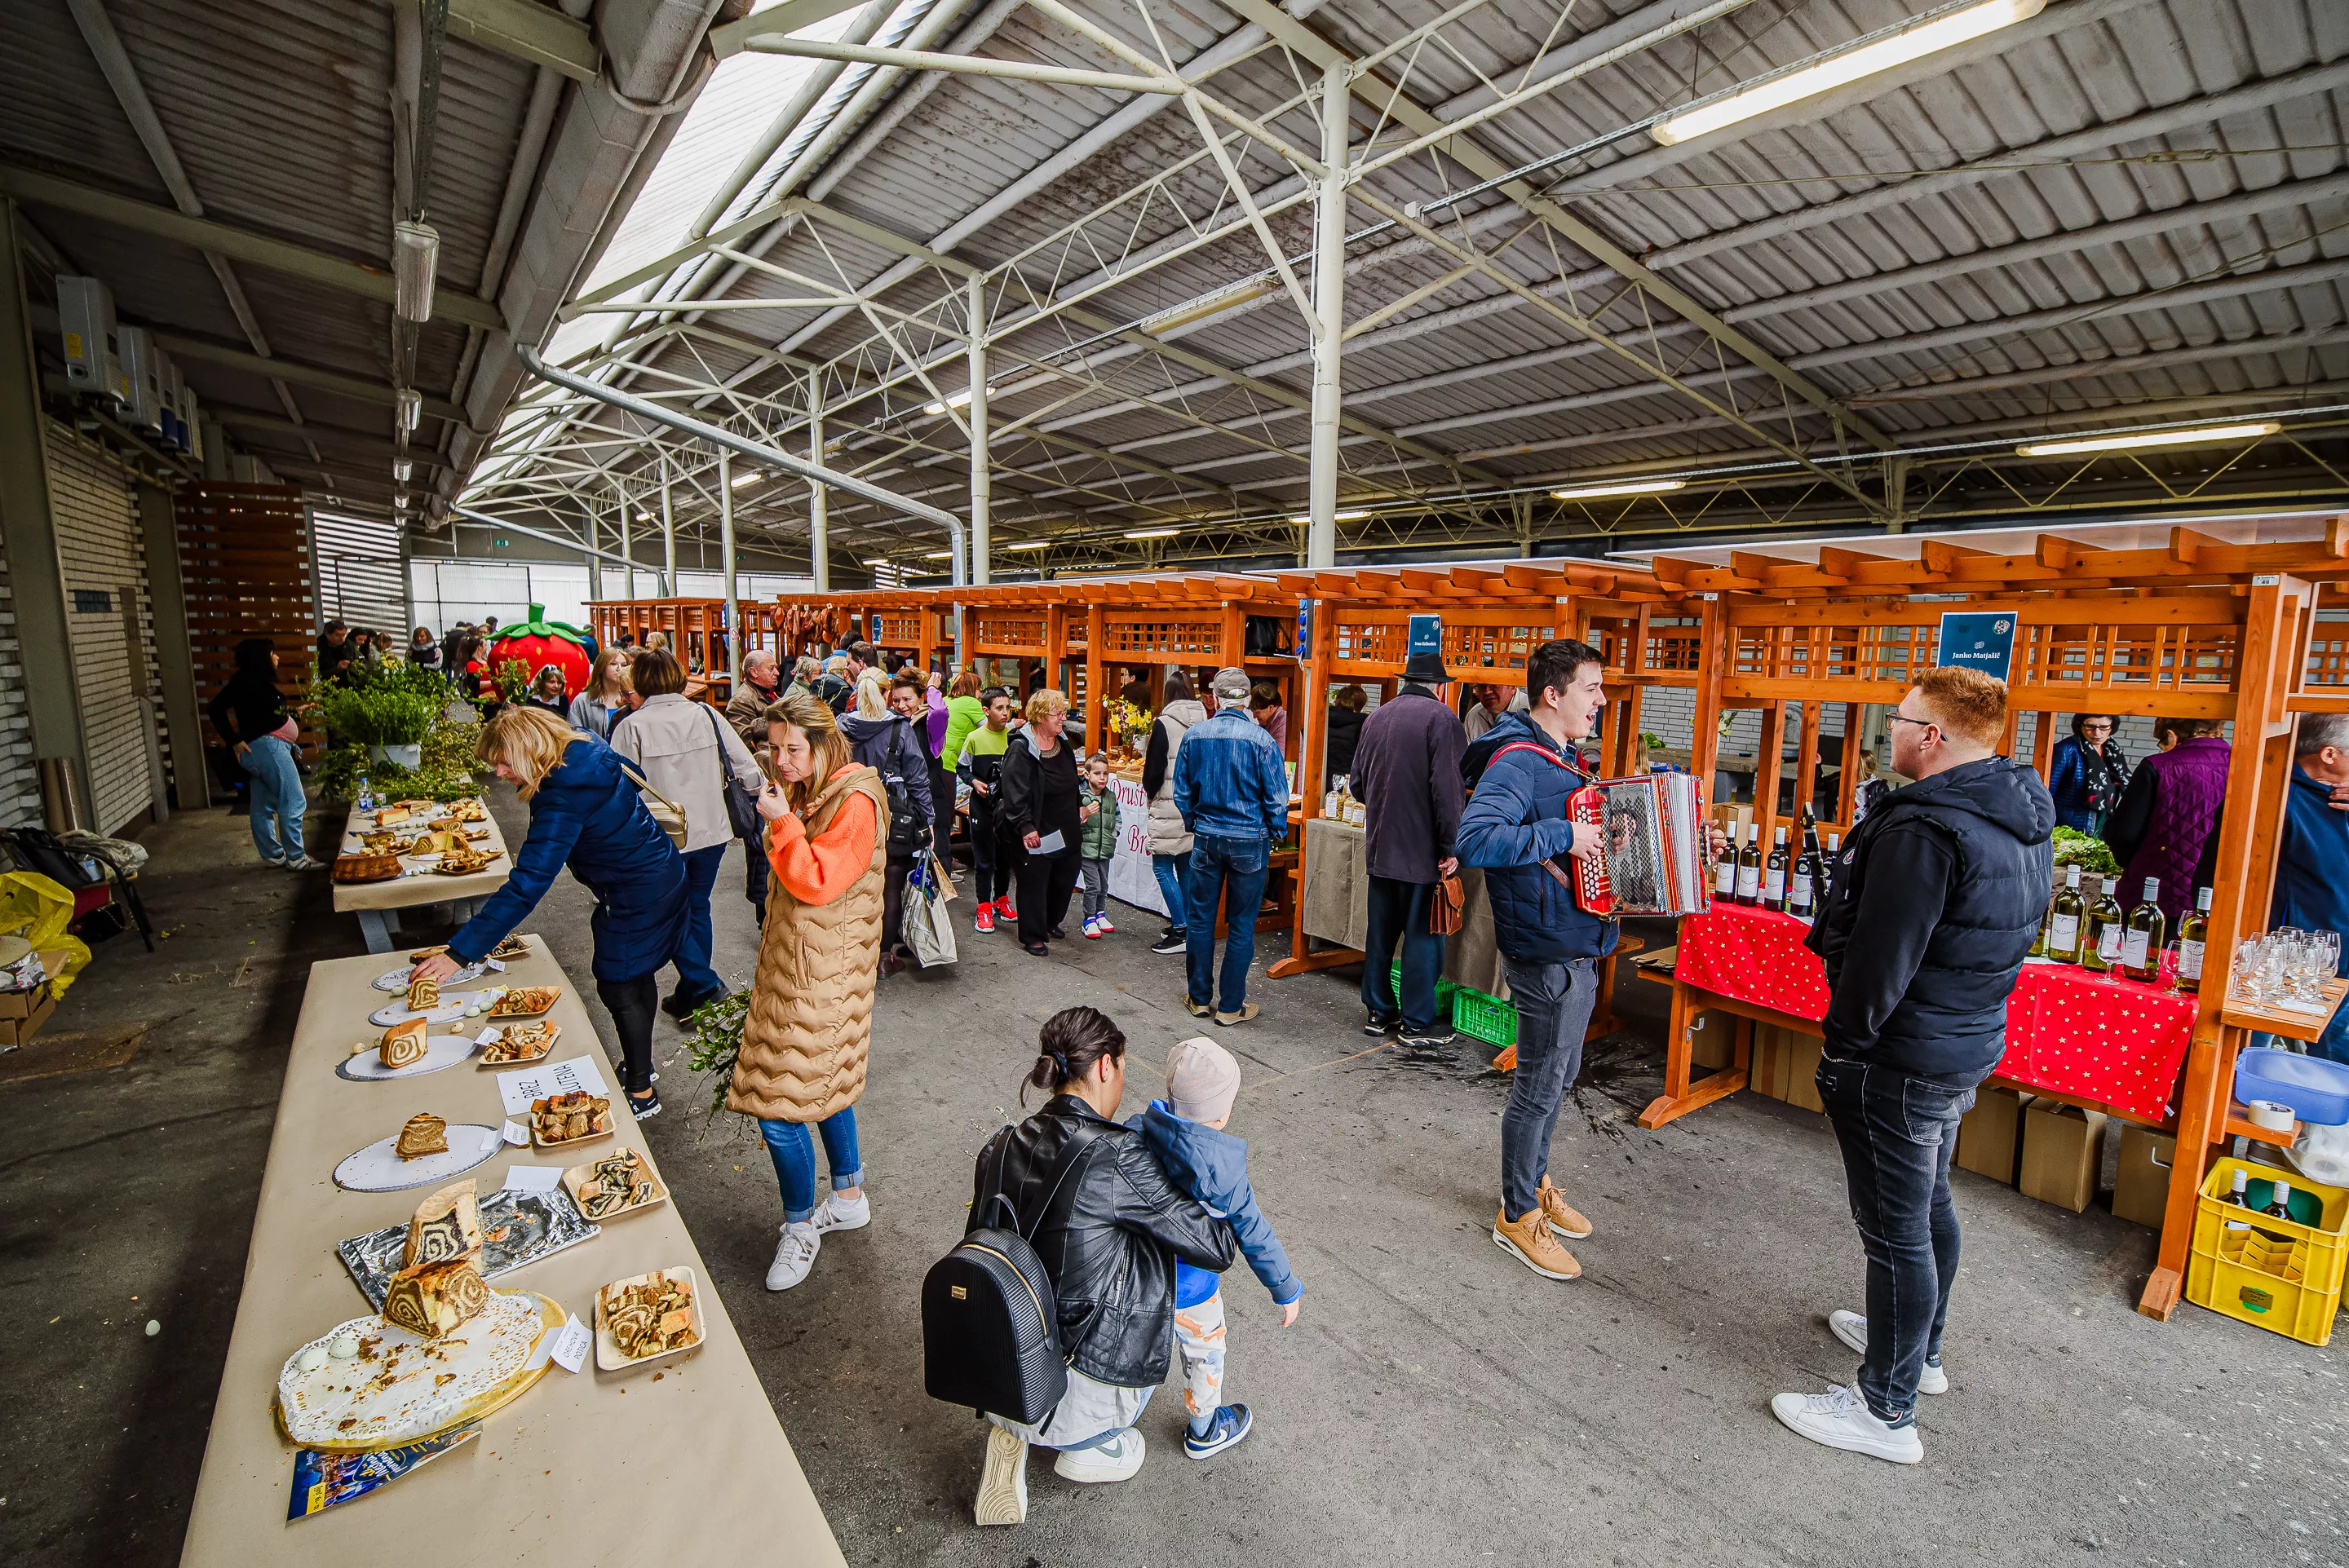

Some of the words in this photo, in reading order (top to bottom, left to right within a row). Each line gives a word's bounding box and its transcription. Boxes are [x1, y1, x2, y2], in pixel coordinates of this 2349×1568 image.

[1972, 651, 2001, 660] Matjašič
[552, 1063, 582, 1093] LUTENA
[518, 1079, 543, 1099] BREZ
[563, 1332, 580, 1358] OREHOVA
[573, 1341, 588, 1359] POTICA
